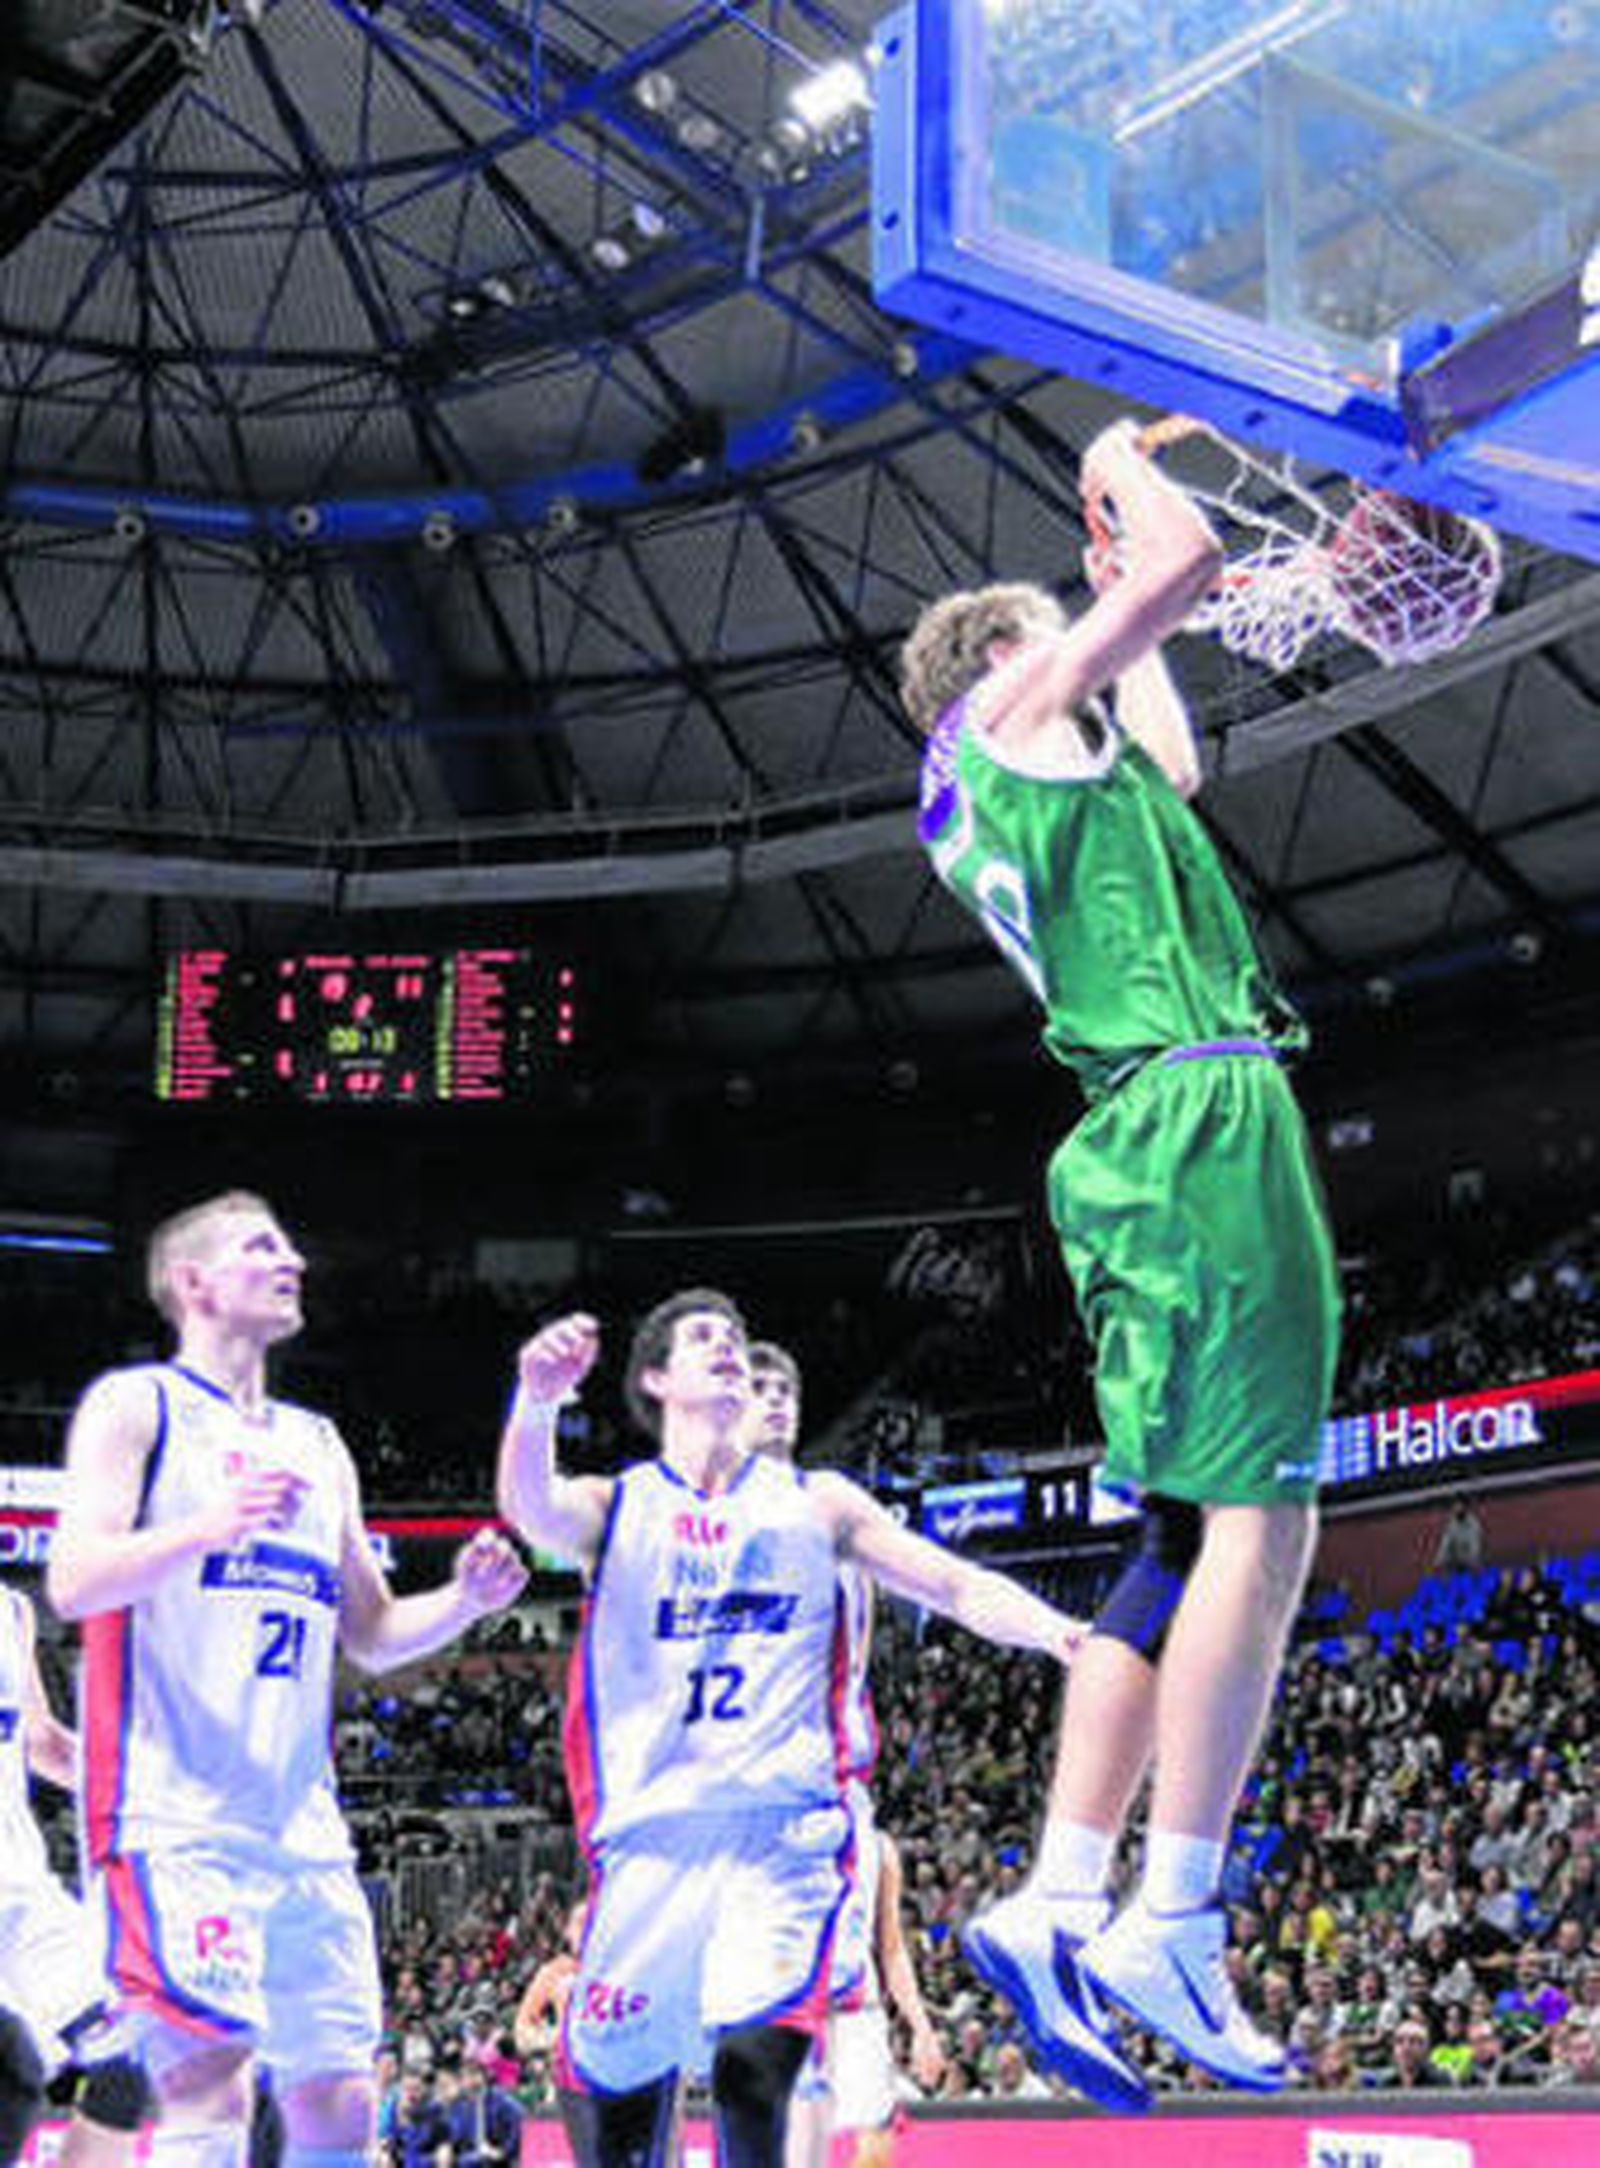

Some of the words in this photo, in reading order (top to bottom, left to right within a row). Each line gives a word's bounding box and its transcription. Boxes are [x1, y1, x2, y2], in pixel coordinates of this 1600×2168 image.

[1376, 1400, 1543, 1471] Halcon
[1040, 1480, 1078, 1519] 11
[255, 1611, 306, 1681] 21
[683, 1664, 746, 1725] 12
